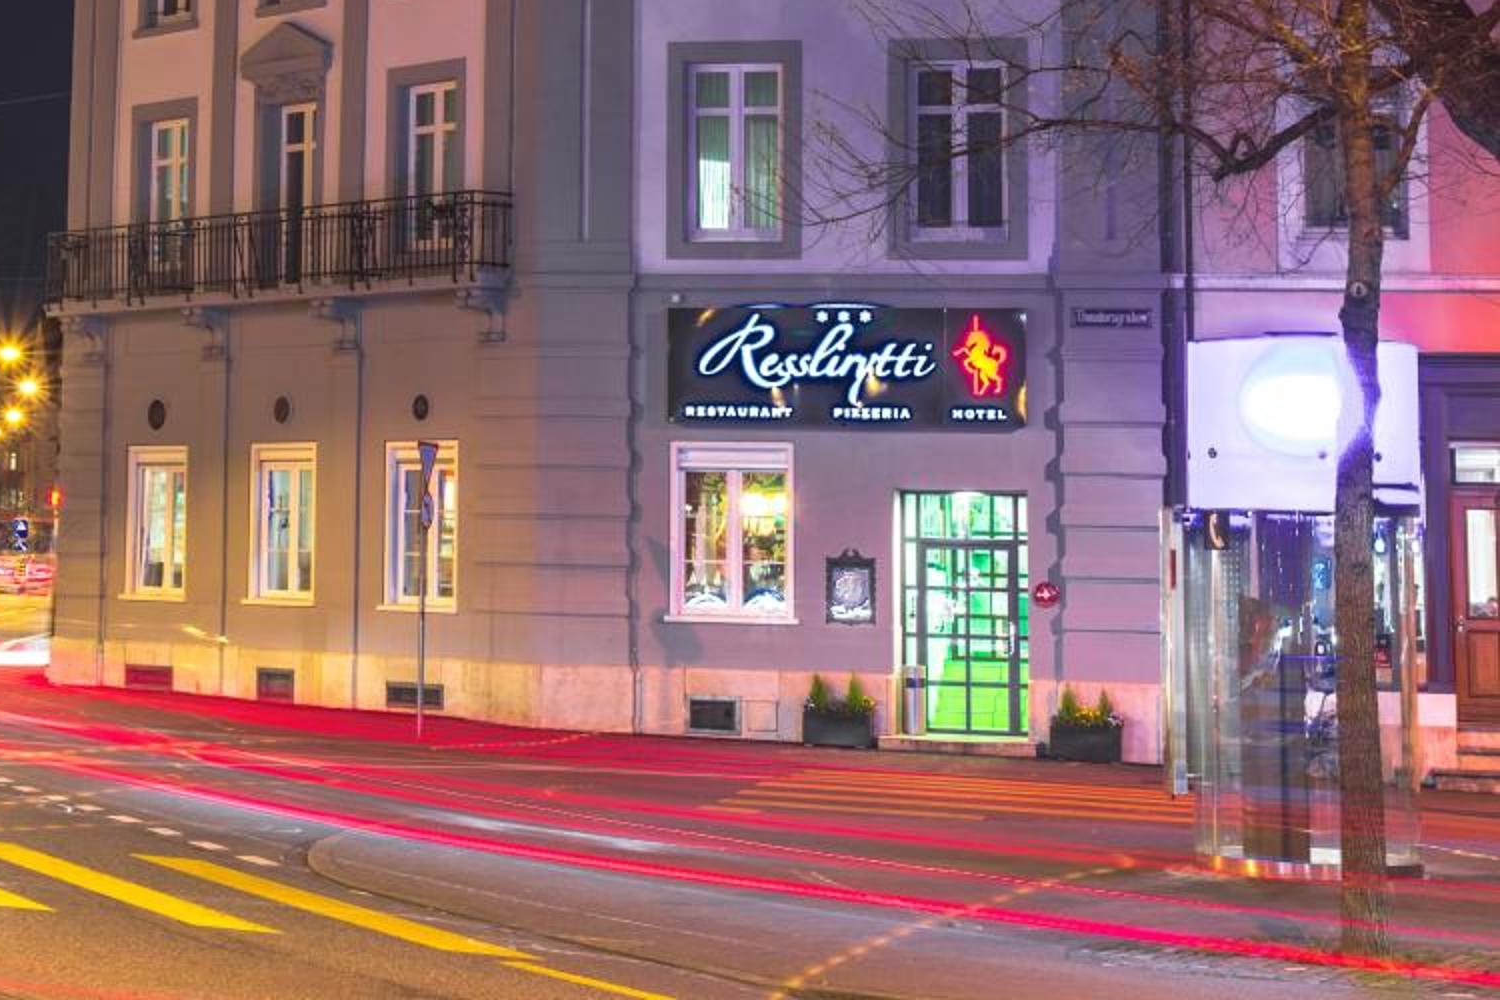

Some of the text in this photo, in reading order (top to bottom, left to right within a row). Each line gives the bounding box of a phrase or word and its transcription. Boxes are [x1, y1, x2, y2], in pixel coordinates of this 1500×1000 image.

[684, 405, 1008, 421] RESTAURANT PIZZERIA HOTEL
